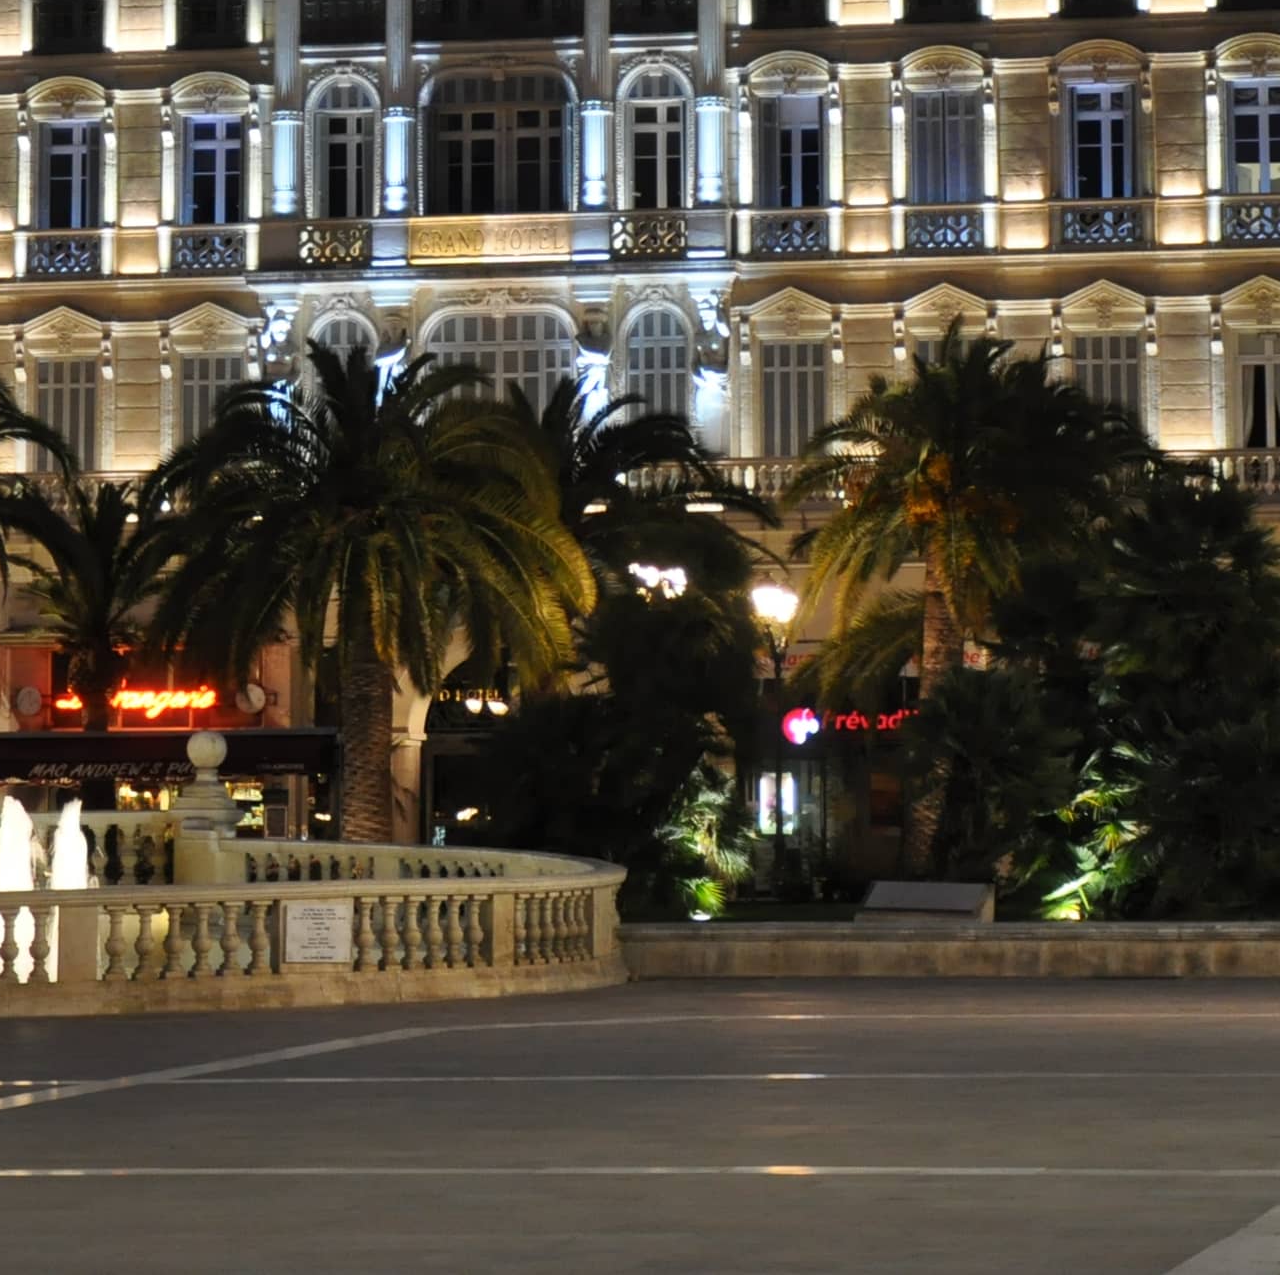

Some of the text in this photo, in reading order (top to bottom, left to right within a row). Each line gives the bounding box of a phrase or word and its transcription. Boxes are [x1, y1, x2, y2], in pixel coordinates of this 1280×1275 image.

[418, 226, 564, 253] GRAND HOTEL
[28, 762, 195, 777] MAC ANDREW'S PU
